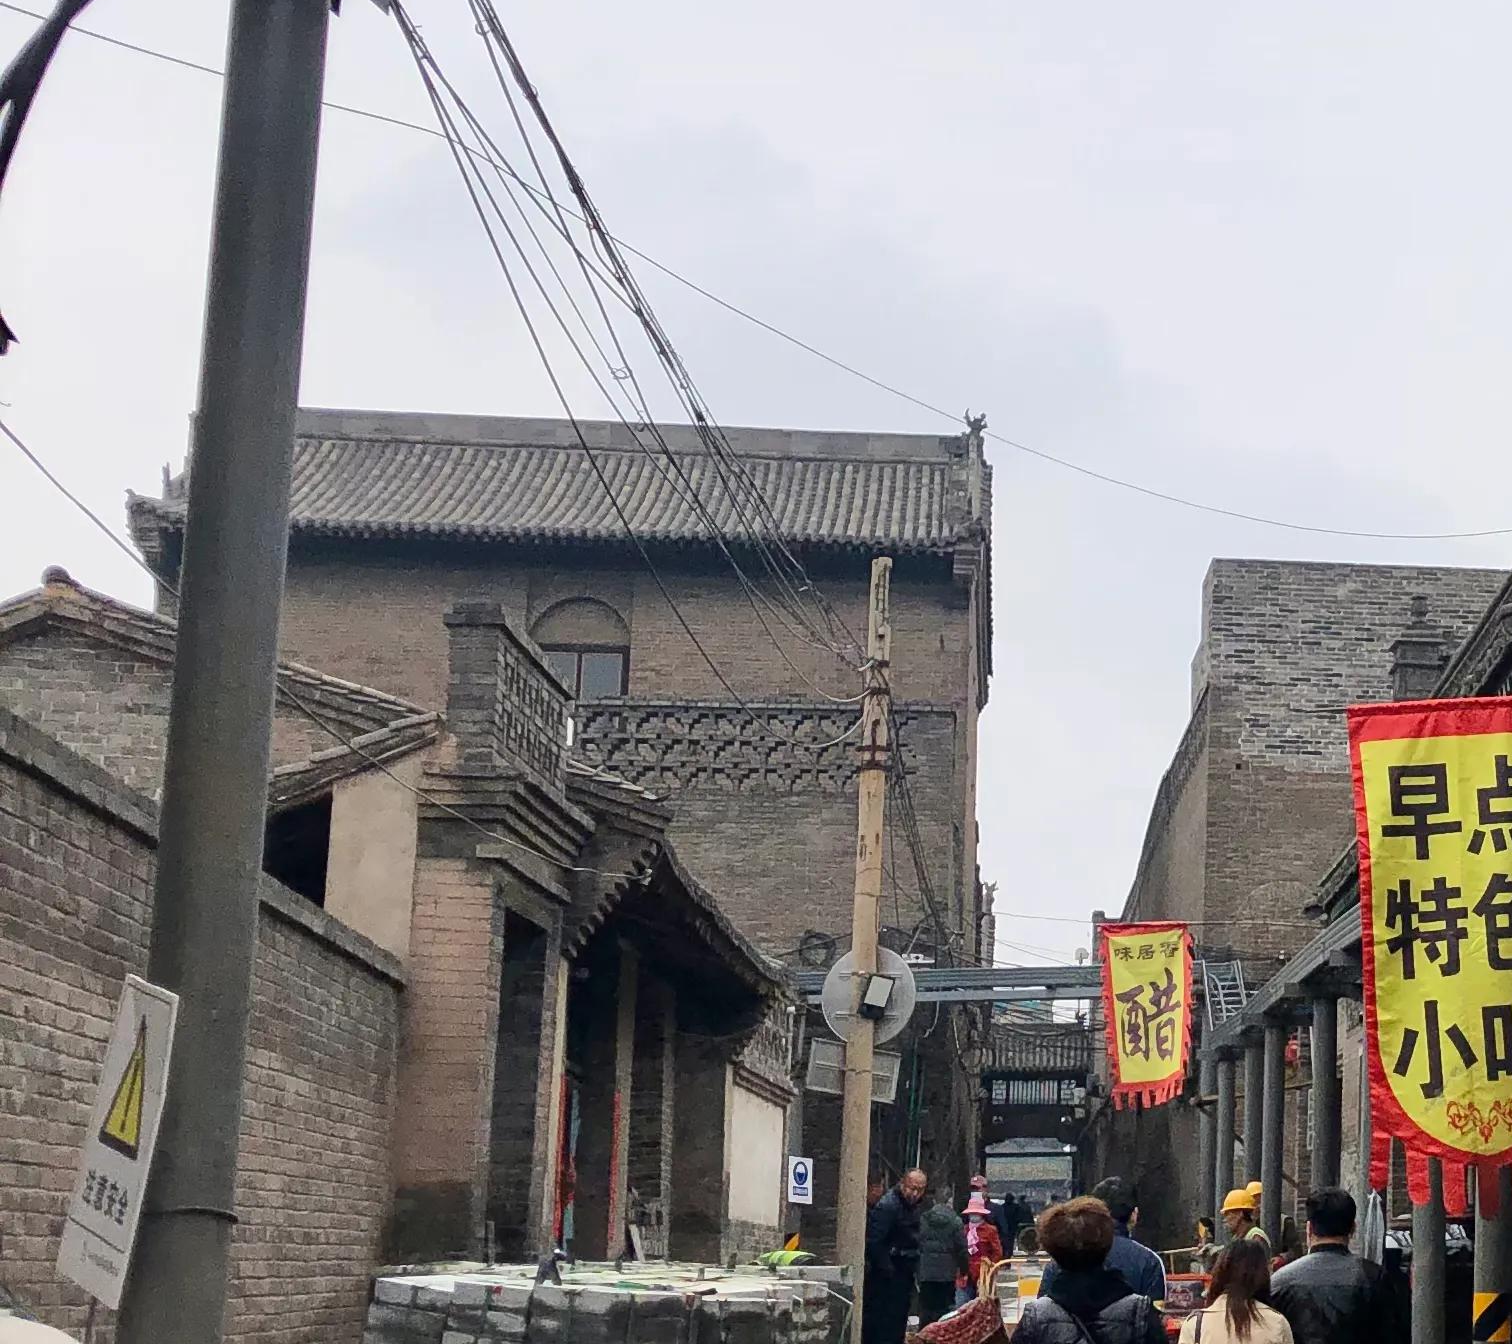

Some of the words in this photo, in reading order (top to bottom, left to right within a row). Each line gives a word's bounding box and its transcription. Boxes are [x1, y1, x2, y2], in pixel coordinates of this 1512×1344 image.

[1115, 967, 1181, 1062] 醋
[83, 1169, 128, 1225] 注意安全
